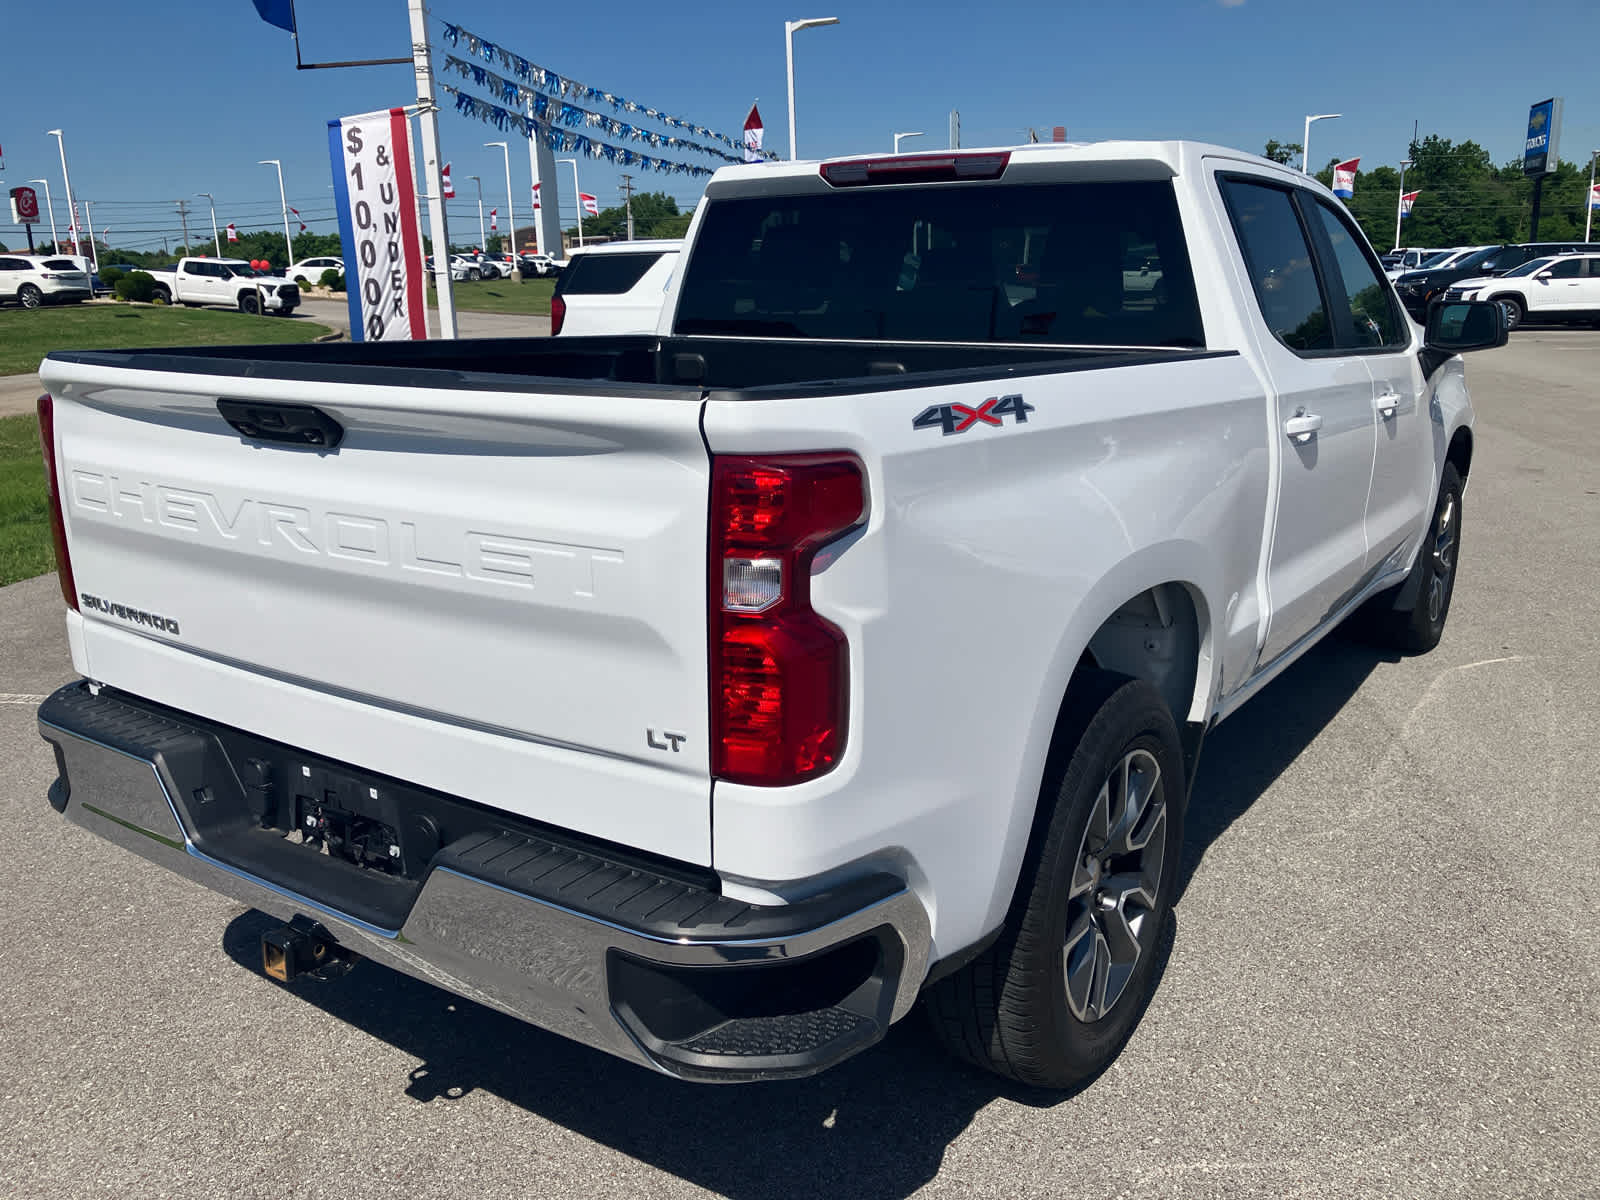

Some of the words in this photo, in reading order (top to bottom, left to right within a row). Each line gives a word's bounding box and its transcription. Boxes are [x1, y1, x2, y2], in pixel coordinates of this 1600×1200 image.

[376, 144, 390, 167] &
[346, 126, 385, 341] $10,000
[380, 182, 405, 318] UNDER
[71, 469, 625, 598] CHEVROLET
[81, 592, 180, 635] SILVERADO
[646, 727, 687, 753] LT
